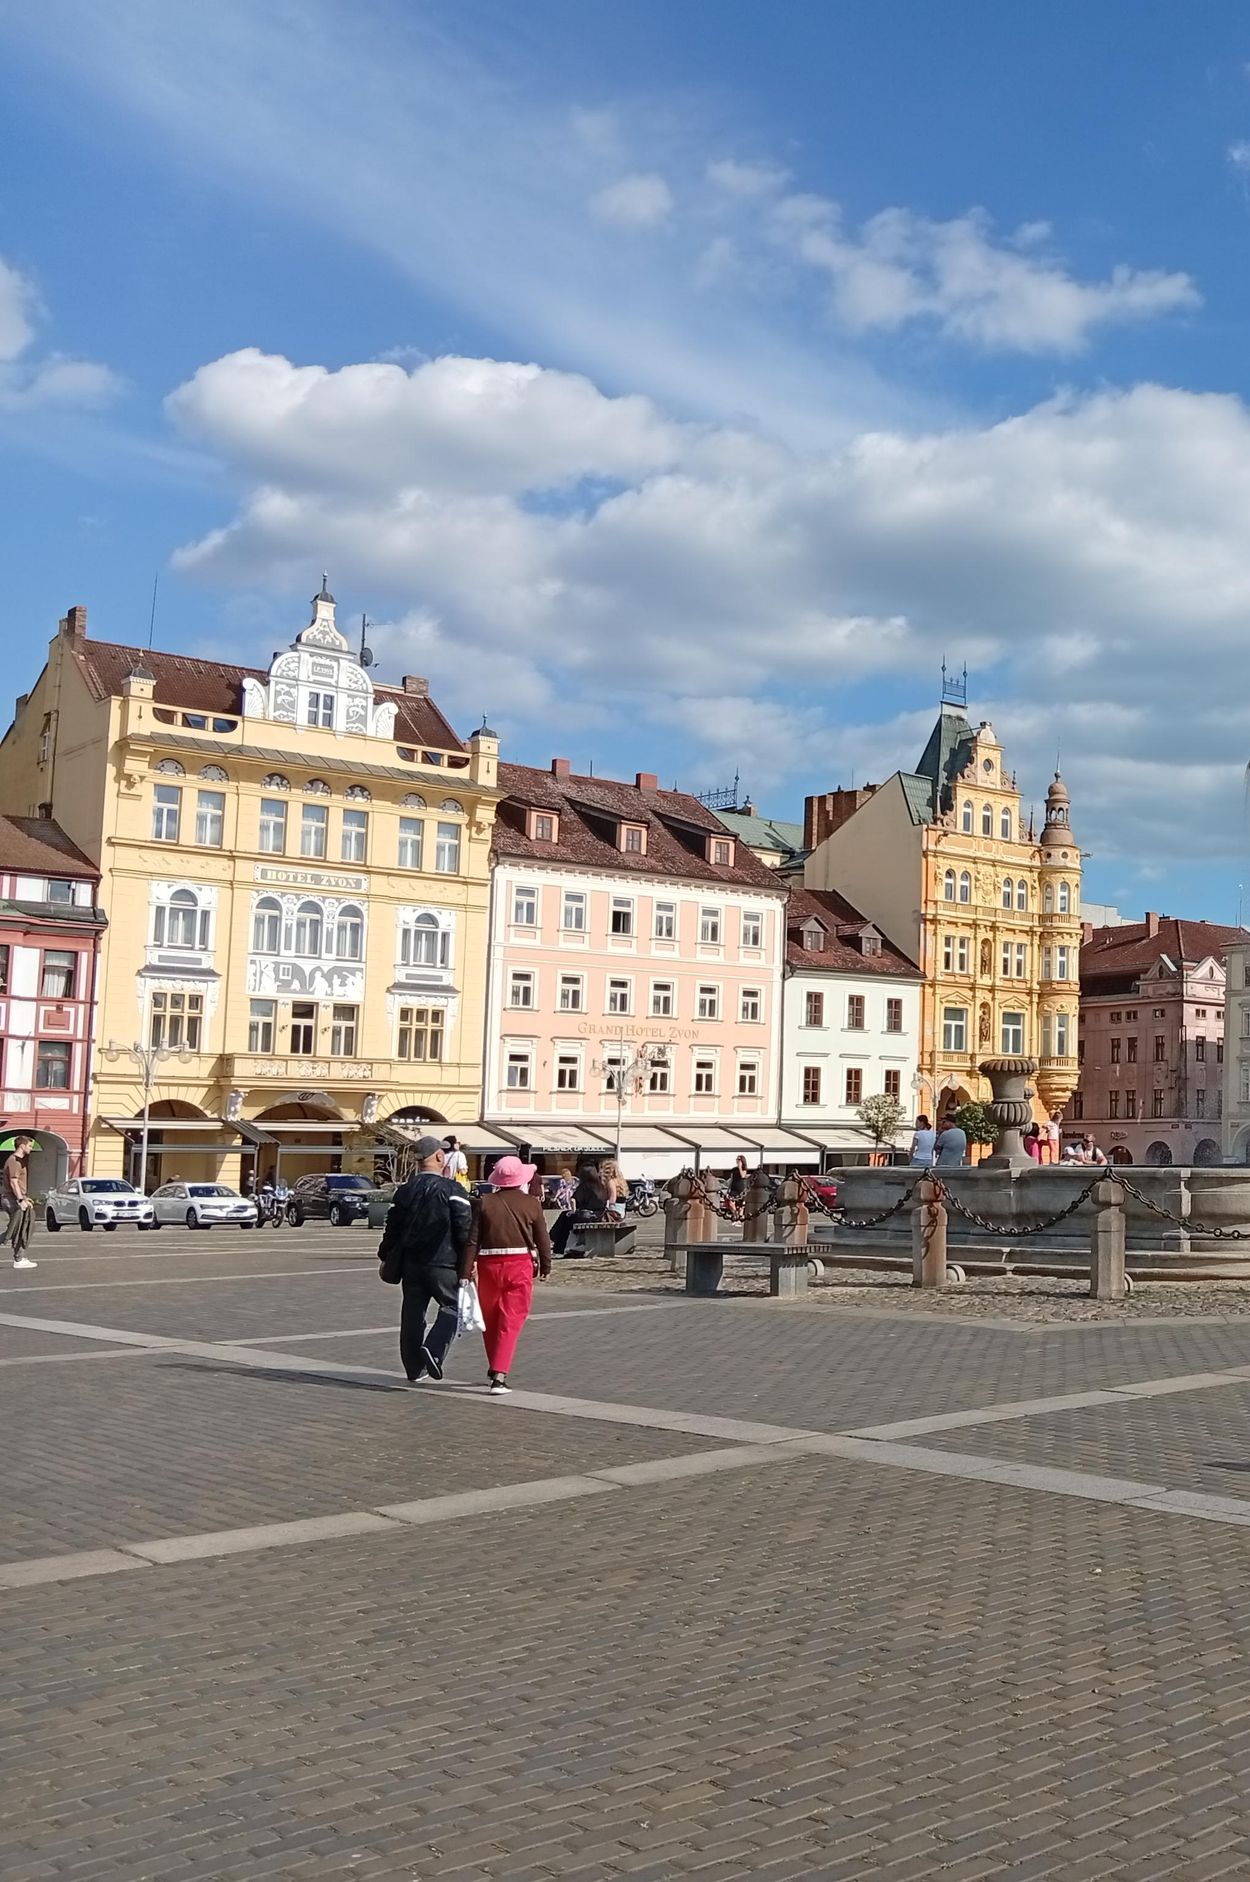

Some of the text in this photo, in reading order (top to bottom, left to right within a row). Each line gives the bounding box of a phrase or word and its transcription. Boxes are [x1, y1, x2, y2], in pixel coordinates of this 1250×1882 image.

[267, 870, 357, 888] HOTEL ZVON
[577, 1022, 700, 1040] GRAND HOTEL ZVON
